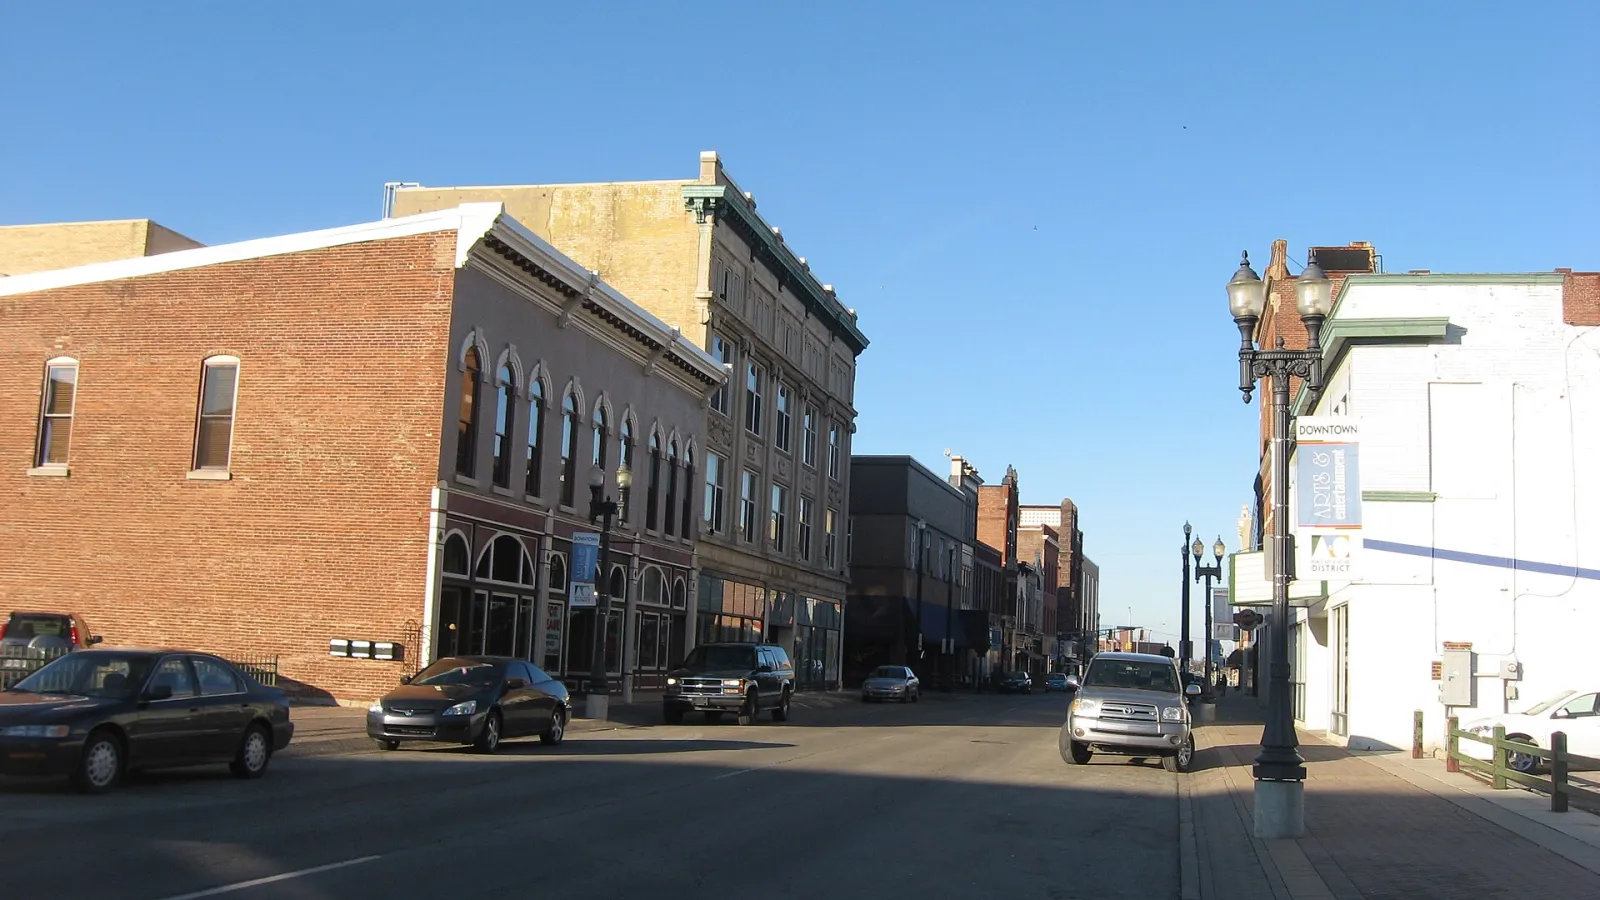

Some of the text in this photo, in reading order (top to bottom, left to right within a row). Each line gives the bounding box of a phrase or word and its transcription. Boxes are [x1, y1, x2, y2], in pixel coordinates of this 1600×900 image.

[1299, 425, 1357, 435] DOWNTOWN
[1313, 472, 1331, 519] ARTS
[1333, 449, 1346, 520] entertainment
[1312, 564, 1350, 572] DISTRICT
